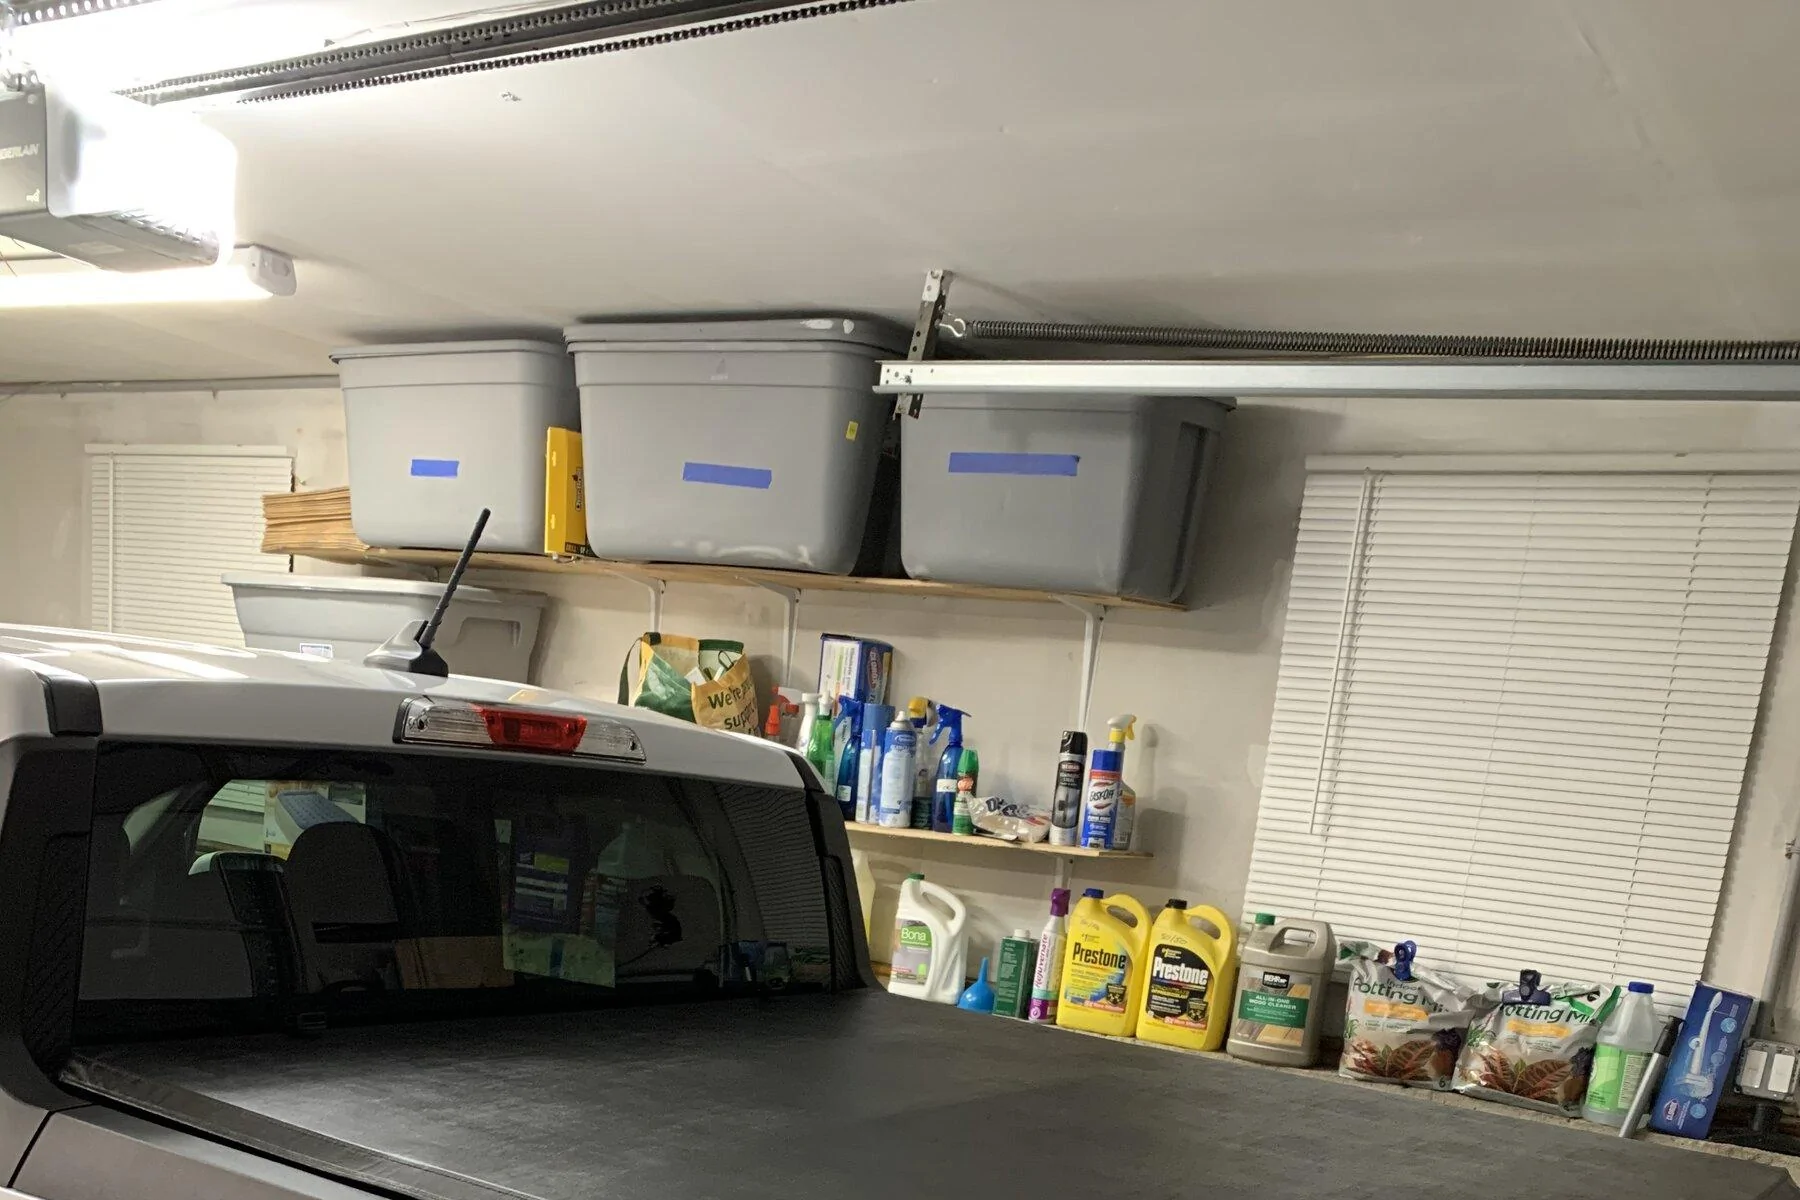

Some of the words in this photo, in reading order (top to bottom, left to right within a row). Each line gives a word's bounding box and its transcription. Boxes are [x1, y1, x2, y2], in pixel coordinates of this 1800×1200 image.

[708, 687, 742, 709] We're
[901, 927, 926, 941] Bona
[1035, 933, 1048, 988] Rejuvenate
[1072, 942, 1127, 970] Prestone
[1153, 956, 1209, 986] Prestone
[1267, 1001, 1297, 1010] CLEANER
[1500, 1003, 1565, 1024] otting
